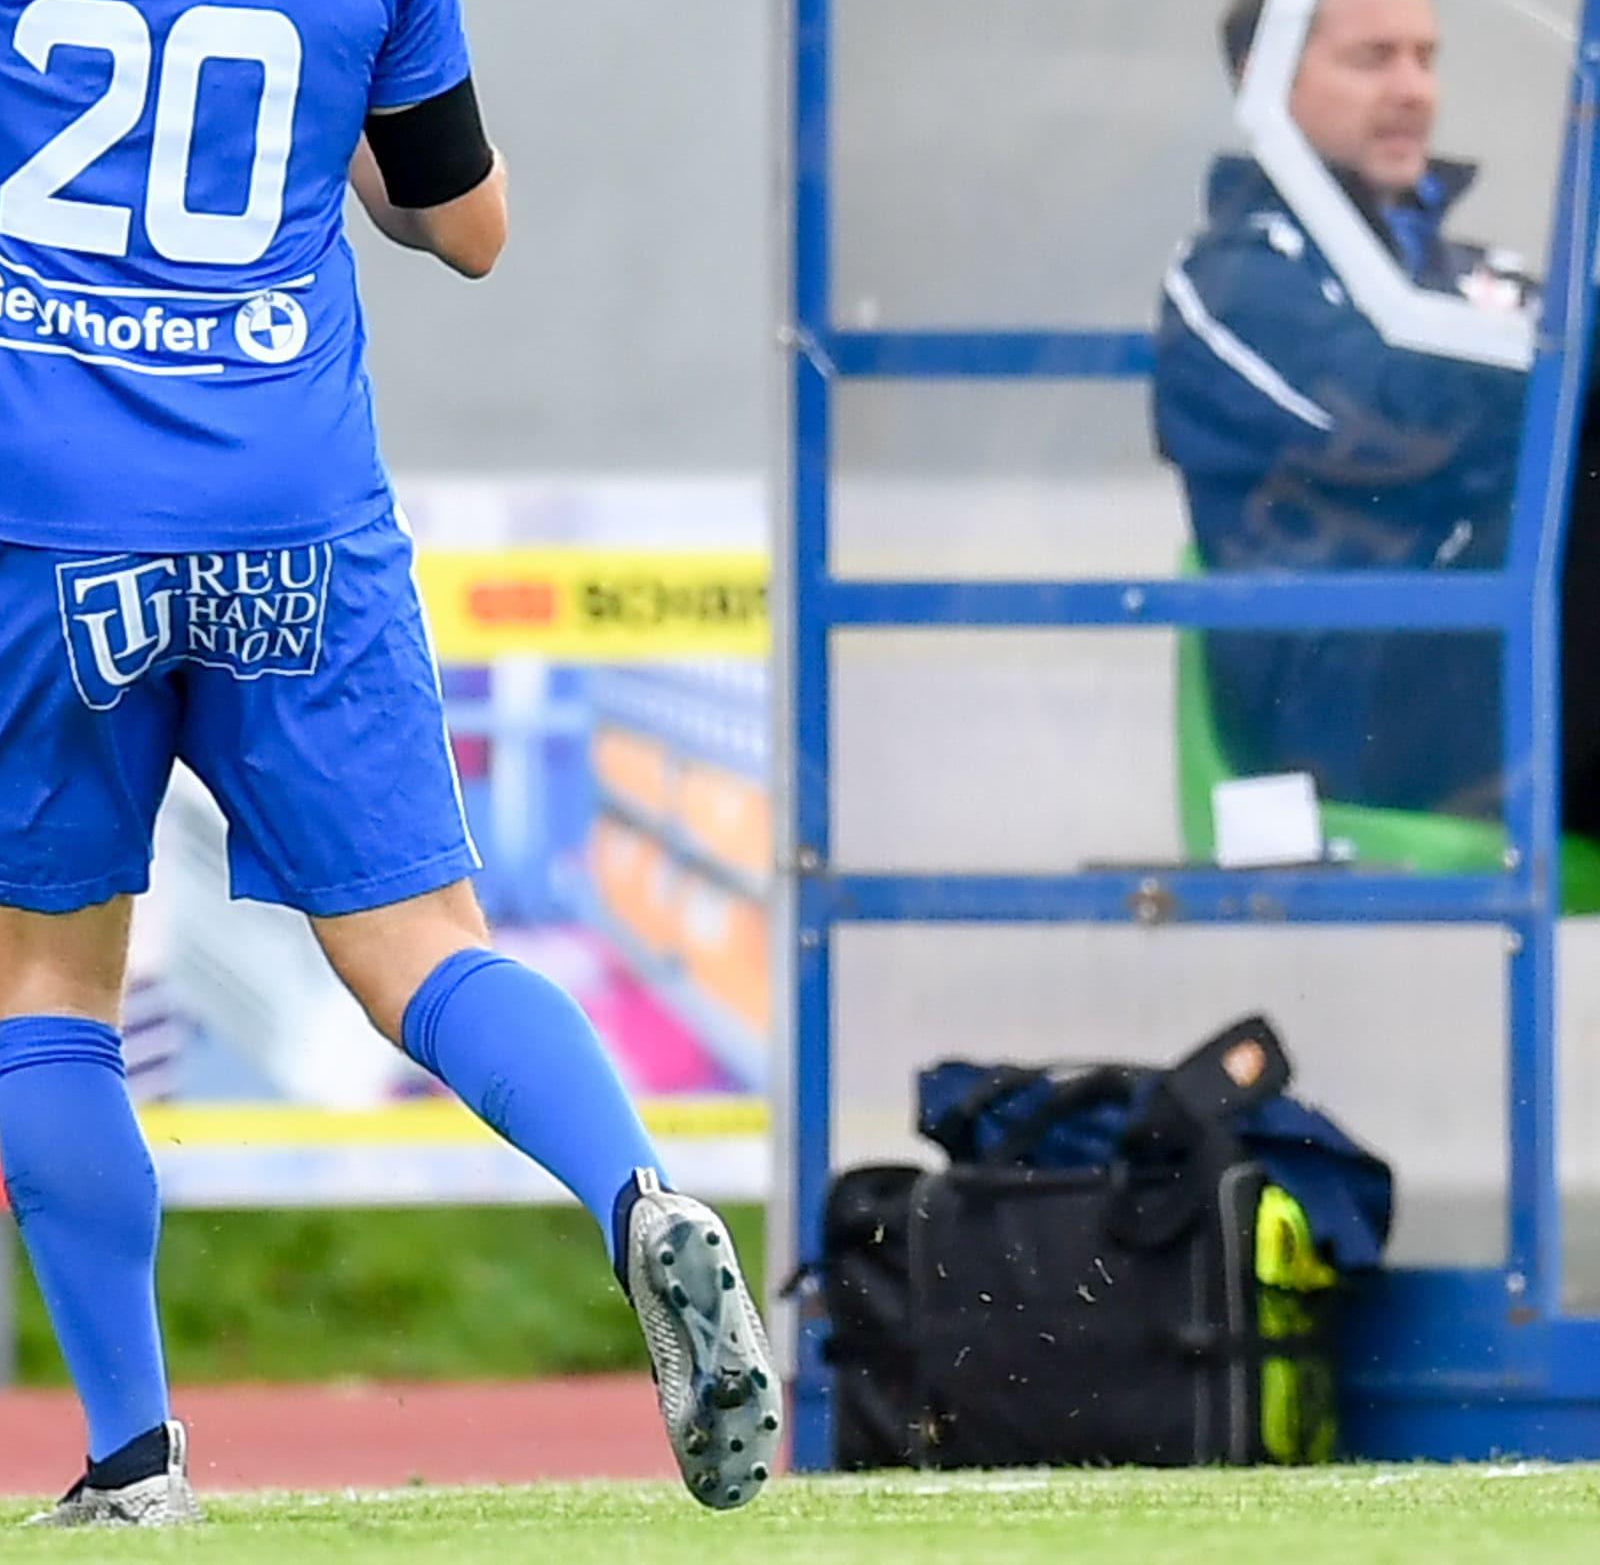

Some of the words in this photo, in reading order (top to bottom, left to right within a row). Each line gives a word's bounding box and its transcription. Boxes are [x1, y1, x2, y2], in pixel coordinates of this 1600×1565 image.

[185, 544, 318, 597] REU
[185, 590, 317, 630] HAND
[187, 625, 314, 664] NION
